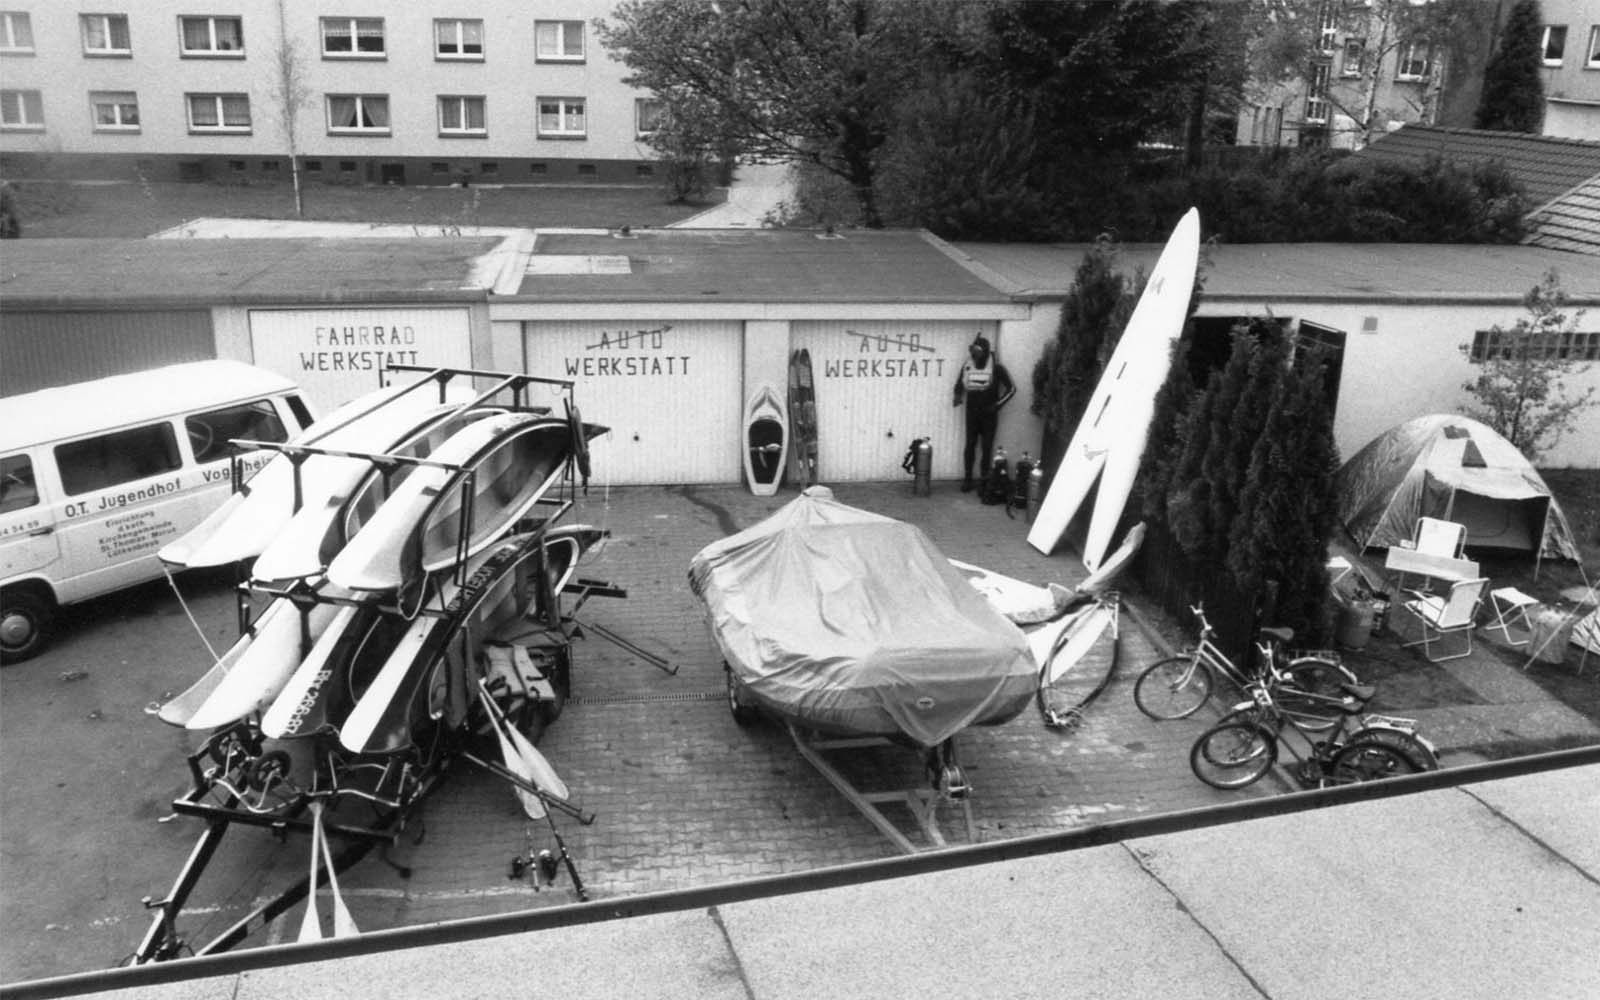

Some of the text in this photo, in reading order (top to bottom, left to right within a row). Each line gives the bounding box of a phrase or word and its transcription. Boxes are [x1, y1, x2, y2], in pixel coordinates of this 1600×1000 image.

[315, 326, 415, 345] FAHRRAD
[600, 330, 662, 350] AUTO
[860, 334, 920, 353] AUTO
[299, 351, 418, 371] WERKSTATT
[565, 356, 691, 376] WERKSTATT
[826, 359, 945, 378] WERKSTATT
[65, 502, 90, 518] O.T.
[99, 478, 181, 508] Jugendhof
